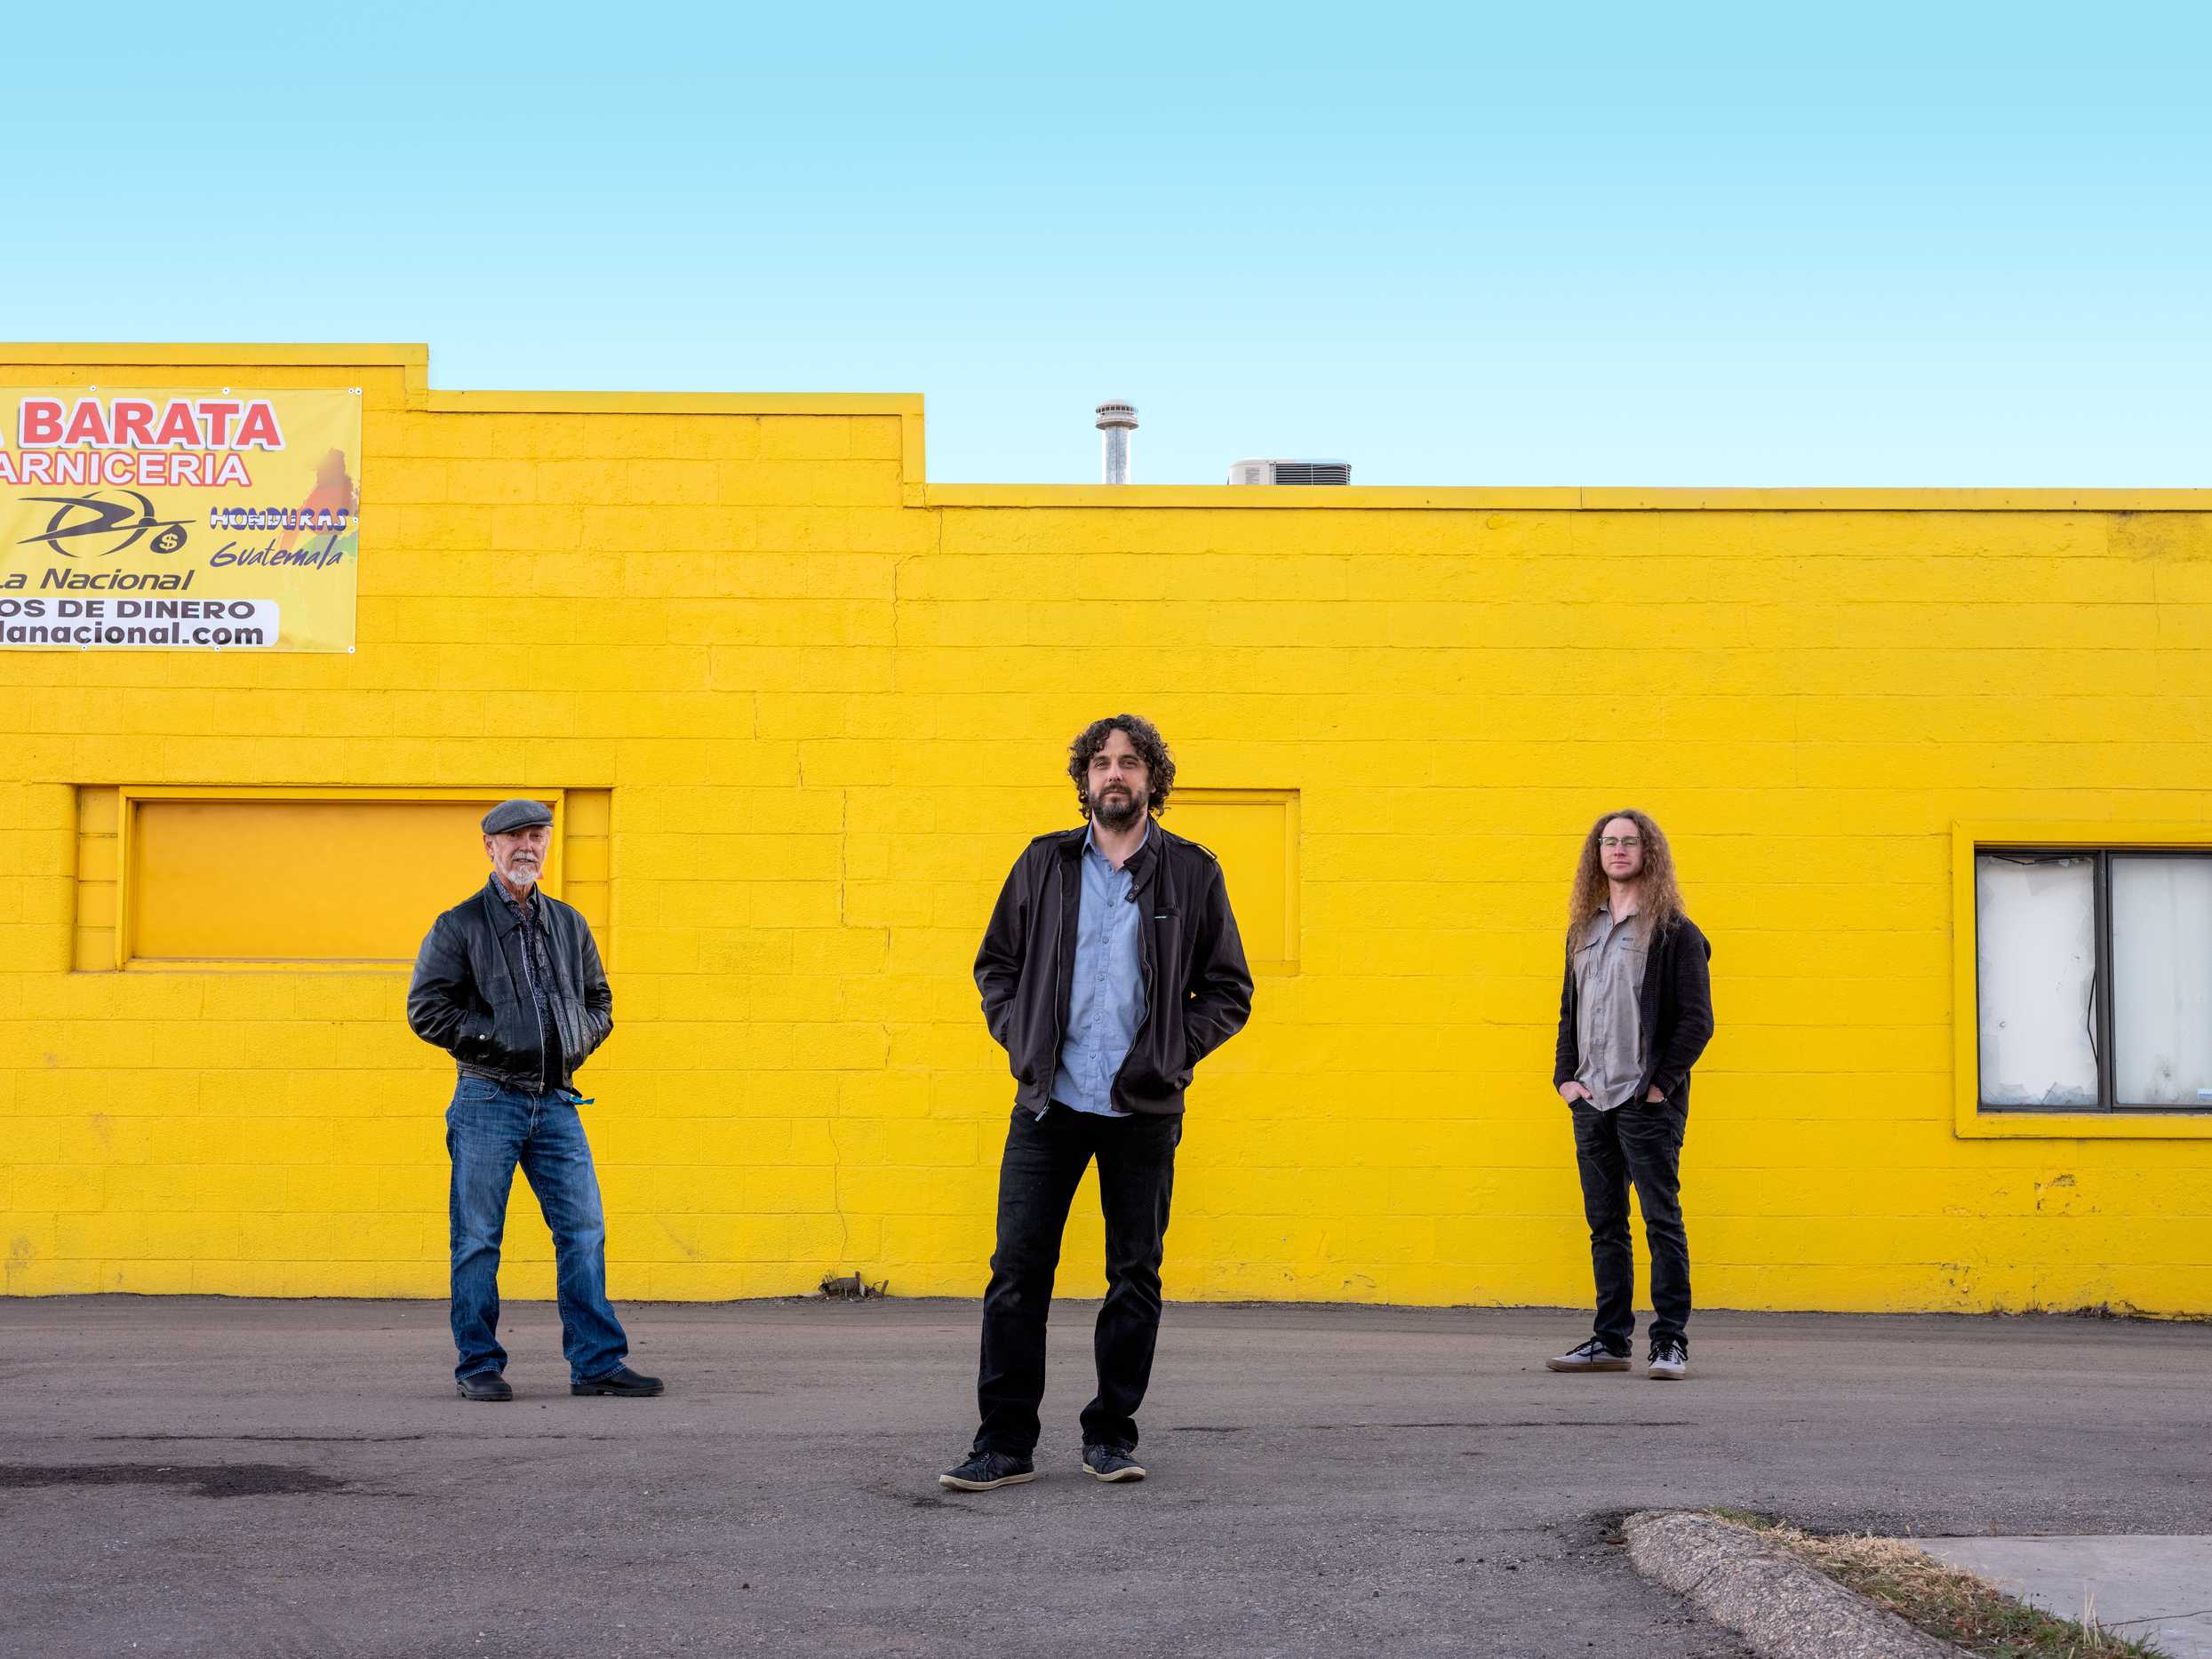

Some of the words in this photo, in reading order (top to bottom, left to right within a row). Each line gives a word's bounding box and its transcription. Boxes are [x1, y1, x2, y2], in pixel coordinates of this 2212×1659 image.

[21, 400, 283, 447] BARATA
[209, 506, 348, 532] HONDURAS
[209, 535, 342, 570] Guatemala
[0, 573, 27, 590] a
[40, 568, 195, 591] Nacional
[58, 600, 105, 618] DE
[116, 601, 255, 619] DINERO
